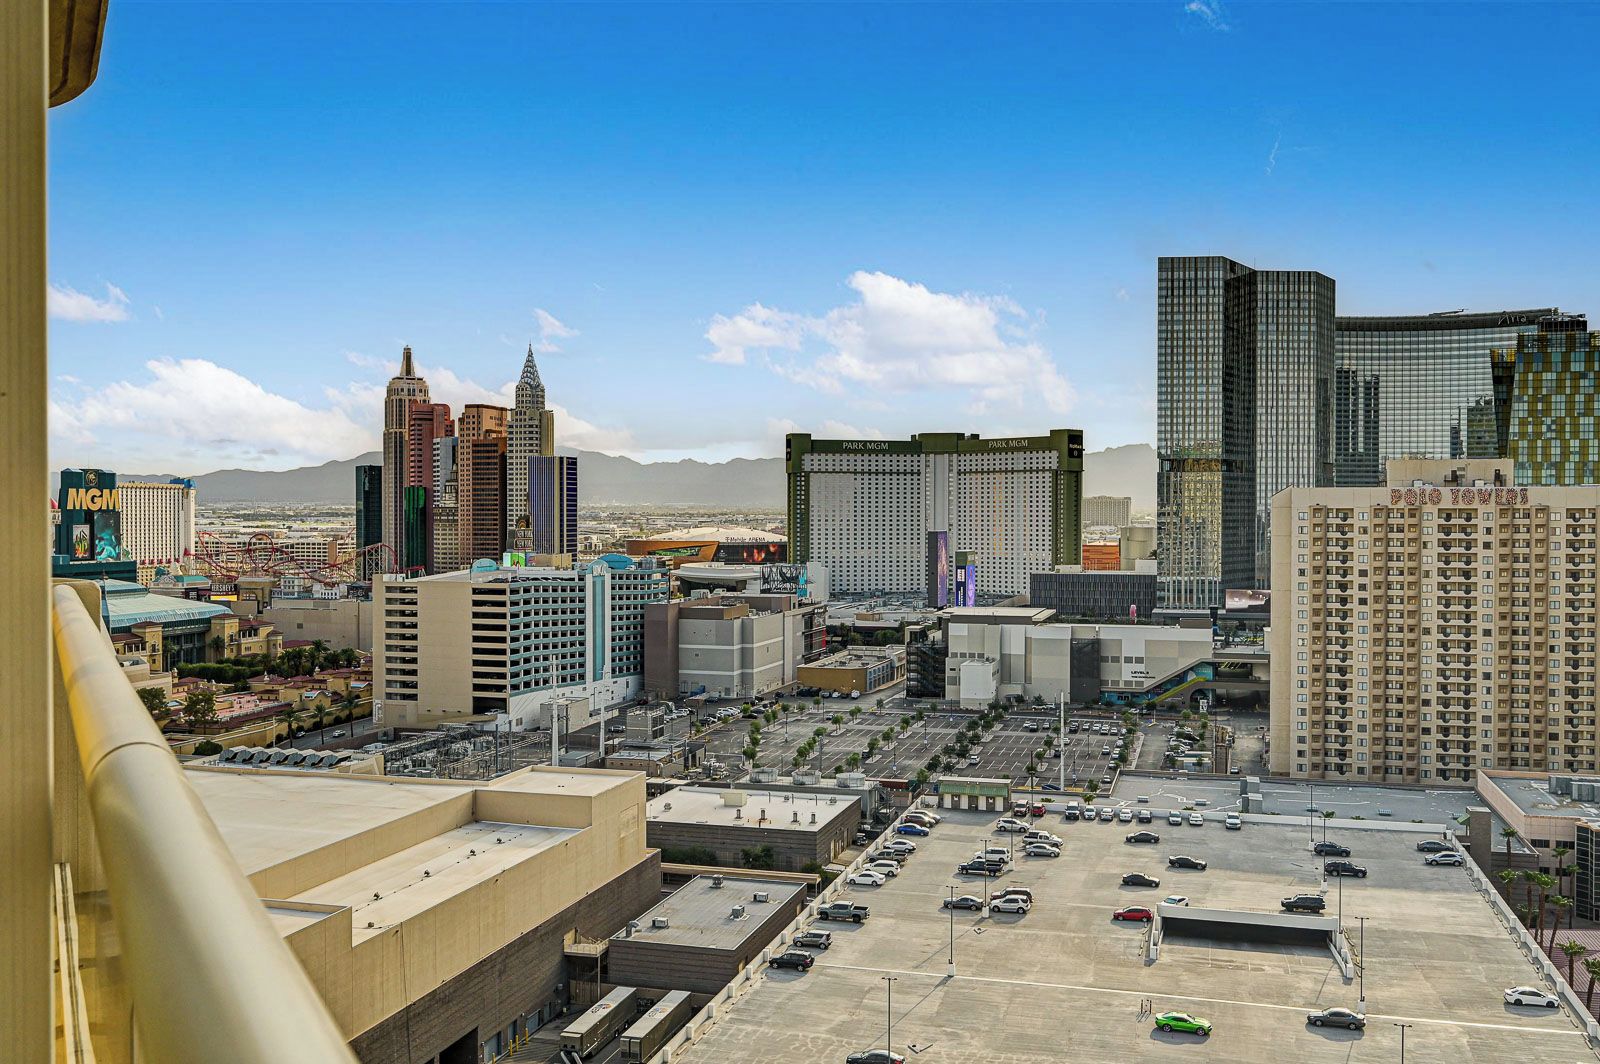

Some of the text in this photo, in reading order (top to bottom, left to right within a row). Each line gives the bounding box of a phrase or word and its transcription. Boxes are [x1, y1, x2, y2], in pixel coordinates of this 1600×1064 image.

[842, 442, 889, 450] PARK MGM
[988, 439, 1028, 449] PARK MGM
[67, 488, 121, 511] MGM
[1391, 488, 1529, 505] POLO TOWERS
